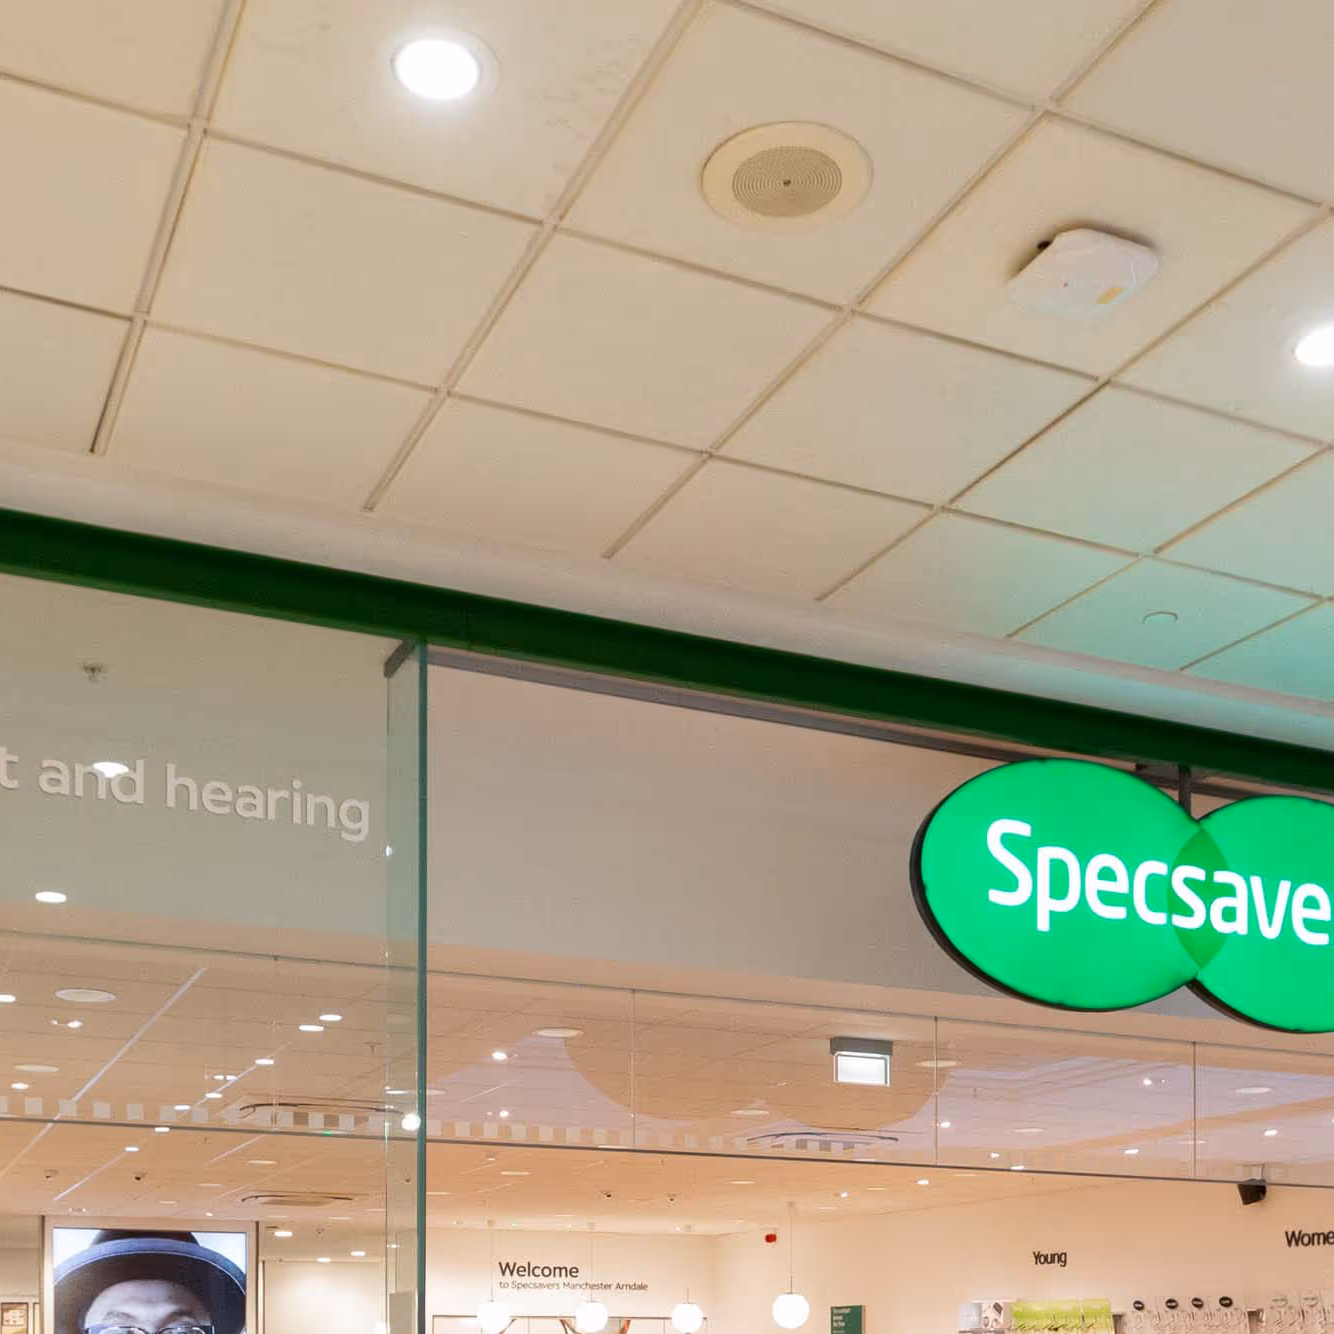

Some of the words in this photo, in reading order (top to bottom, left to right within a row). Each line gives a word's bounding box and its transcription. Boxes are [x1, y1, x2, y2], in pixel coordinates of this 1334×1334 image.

[38, 758, 145, 804] and
[165, 764, 370, 842] hearing
[1033, 1251, 1067, 1267] Young
[499, 1262, 579, 1278] Welcome
[499, 1281, 509, 1289] to
[511, 1281, 560, 1290] Specsavers
[563, 1282, 612, 1290] Manchester
[616, 1282, 648, 1291] Arndale
